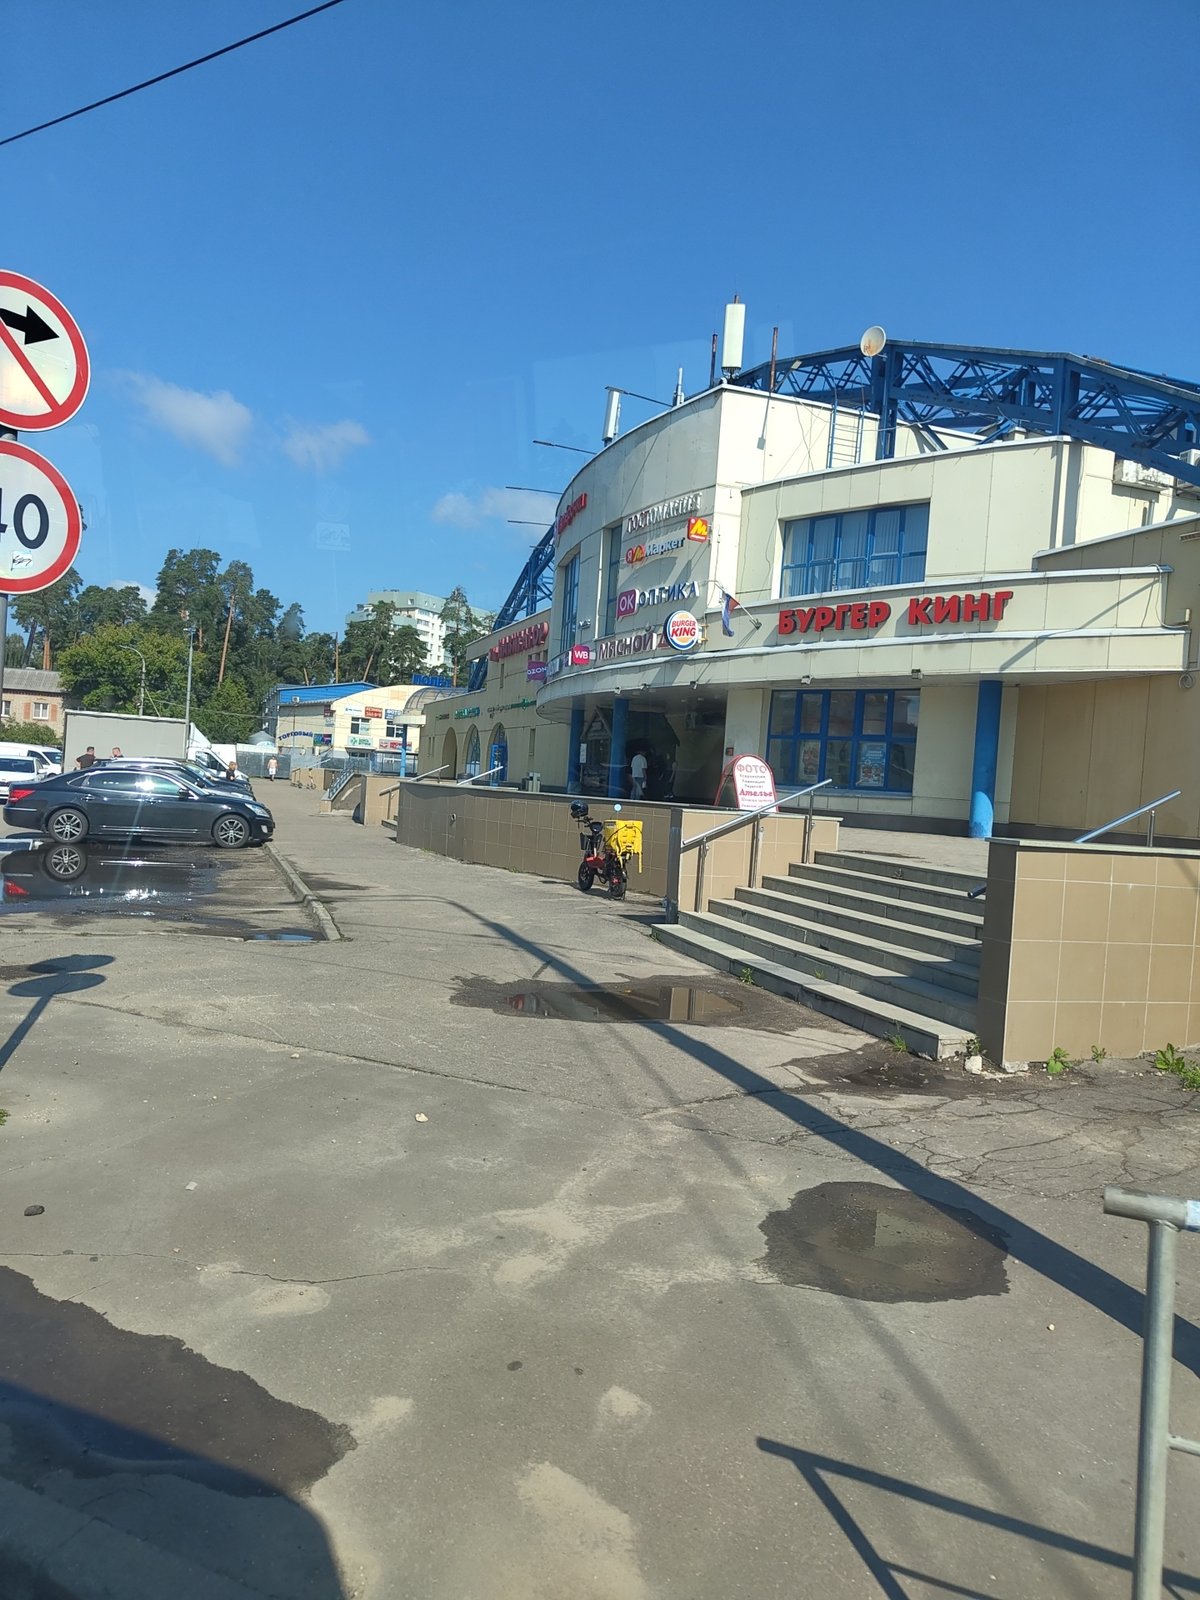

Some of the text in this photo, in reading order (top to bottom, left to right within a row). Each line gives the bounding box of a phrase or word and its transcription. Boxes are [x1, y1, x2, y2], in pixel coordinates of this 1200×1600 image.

[638, 581, 700, 607] ОПТИКА
[778, 590, 1014, 635] БУРГЕР КИНГ
[671, 620, 697, 628] BURGER
[671, 627, 697, 637] KING
[599, 632, 657, 658] МЯСНОЙ
[574, 650, 588, 659] WB
[527, 666, 547, 675] OZON
[736, 763, 767, 774] ФОТО
[738, 788, 773, 797] Ателье
